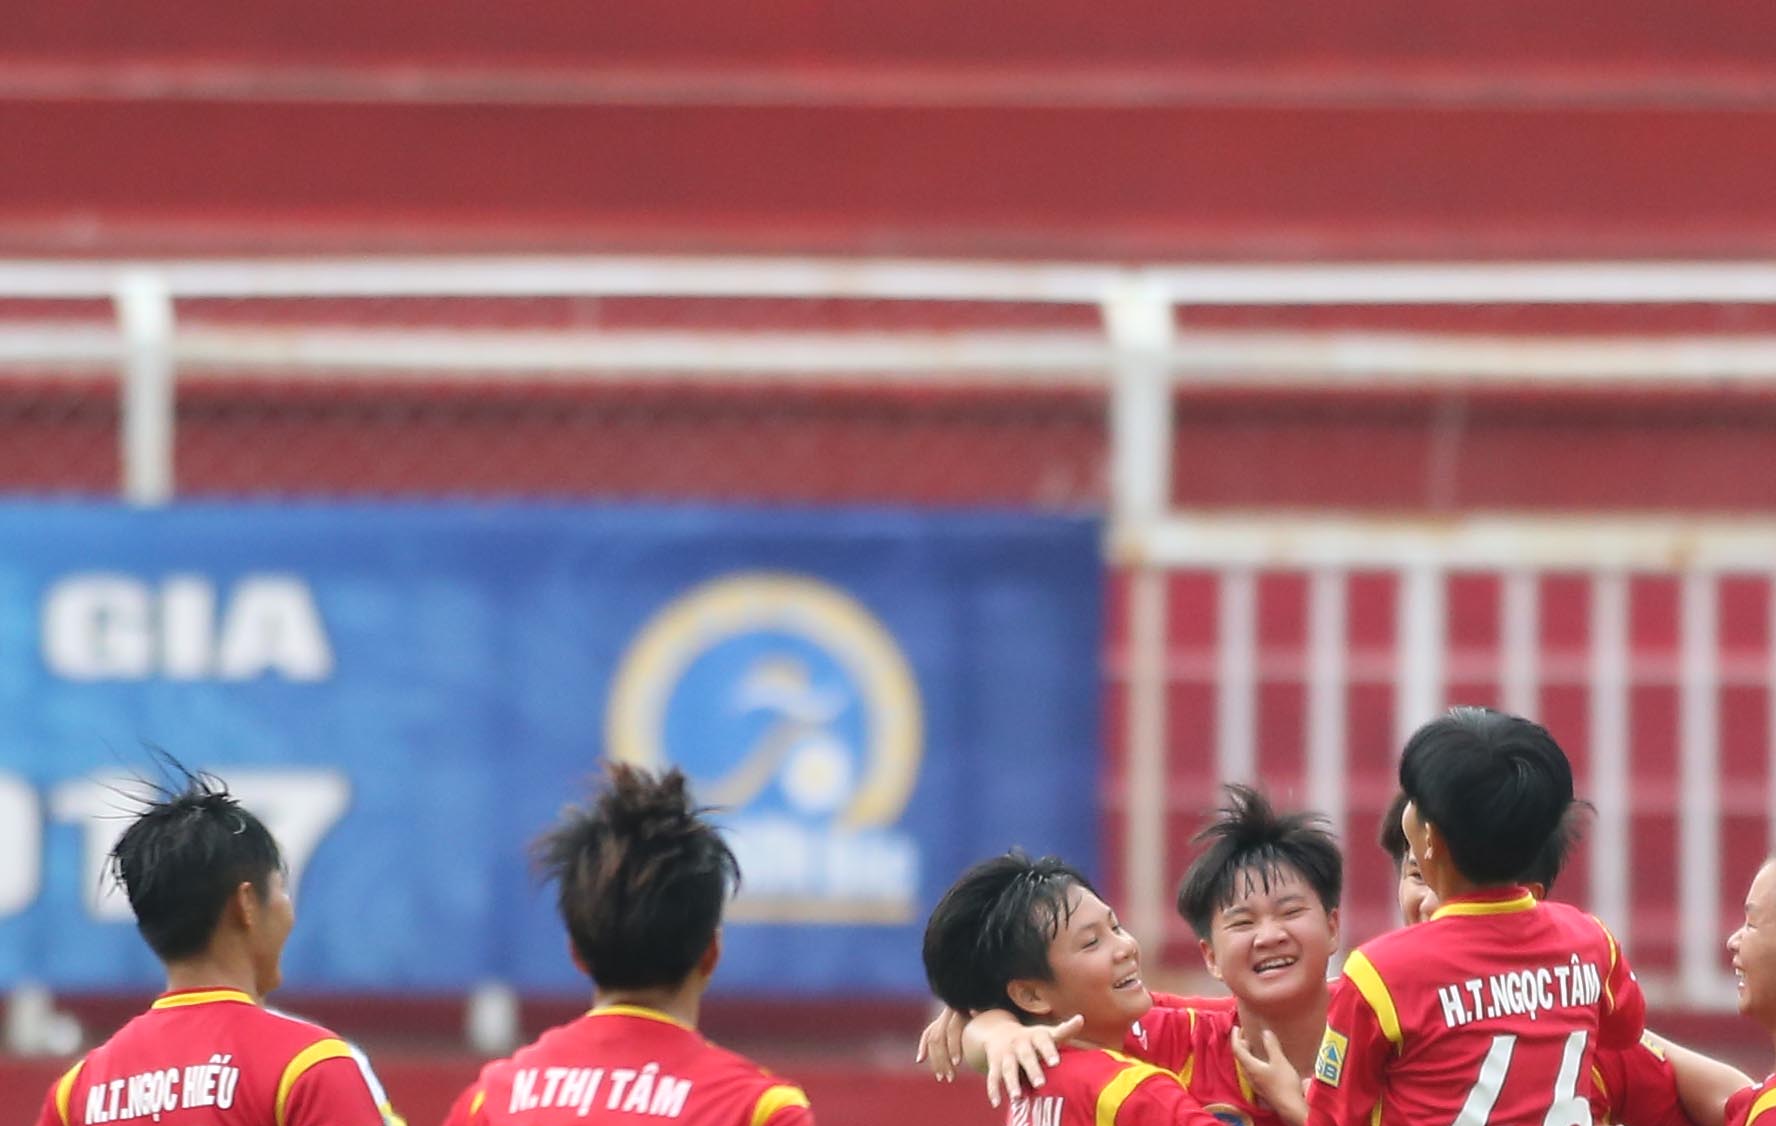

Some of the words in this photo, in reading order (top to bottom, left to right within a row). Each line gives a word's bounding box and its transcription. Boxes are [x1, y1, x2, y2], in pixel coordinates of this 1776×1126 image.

[43, 570, 333, 682] GIA
[1438, 968, 1553, 1028] H.T.NGỌC
[1553, 953, 1601, 1007] TÂM
[84, 1066, 180, 1125] N.T.NGỌC
[181, 1053, 240, 1110] HIẾU
[508, 1067, 602, 1117] N.THỊ
[605, 1062, 693, 1118] TÂM
